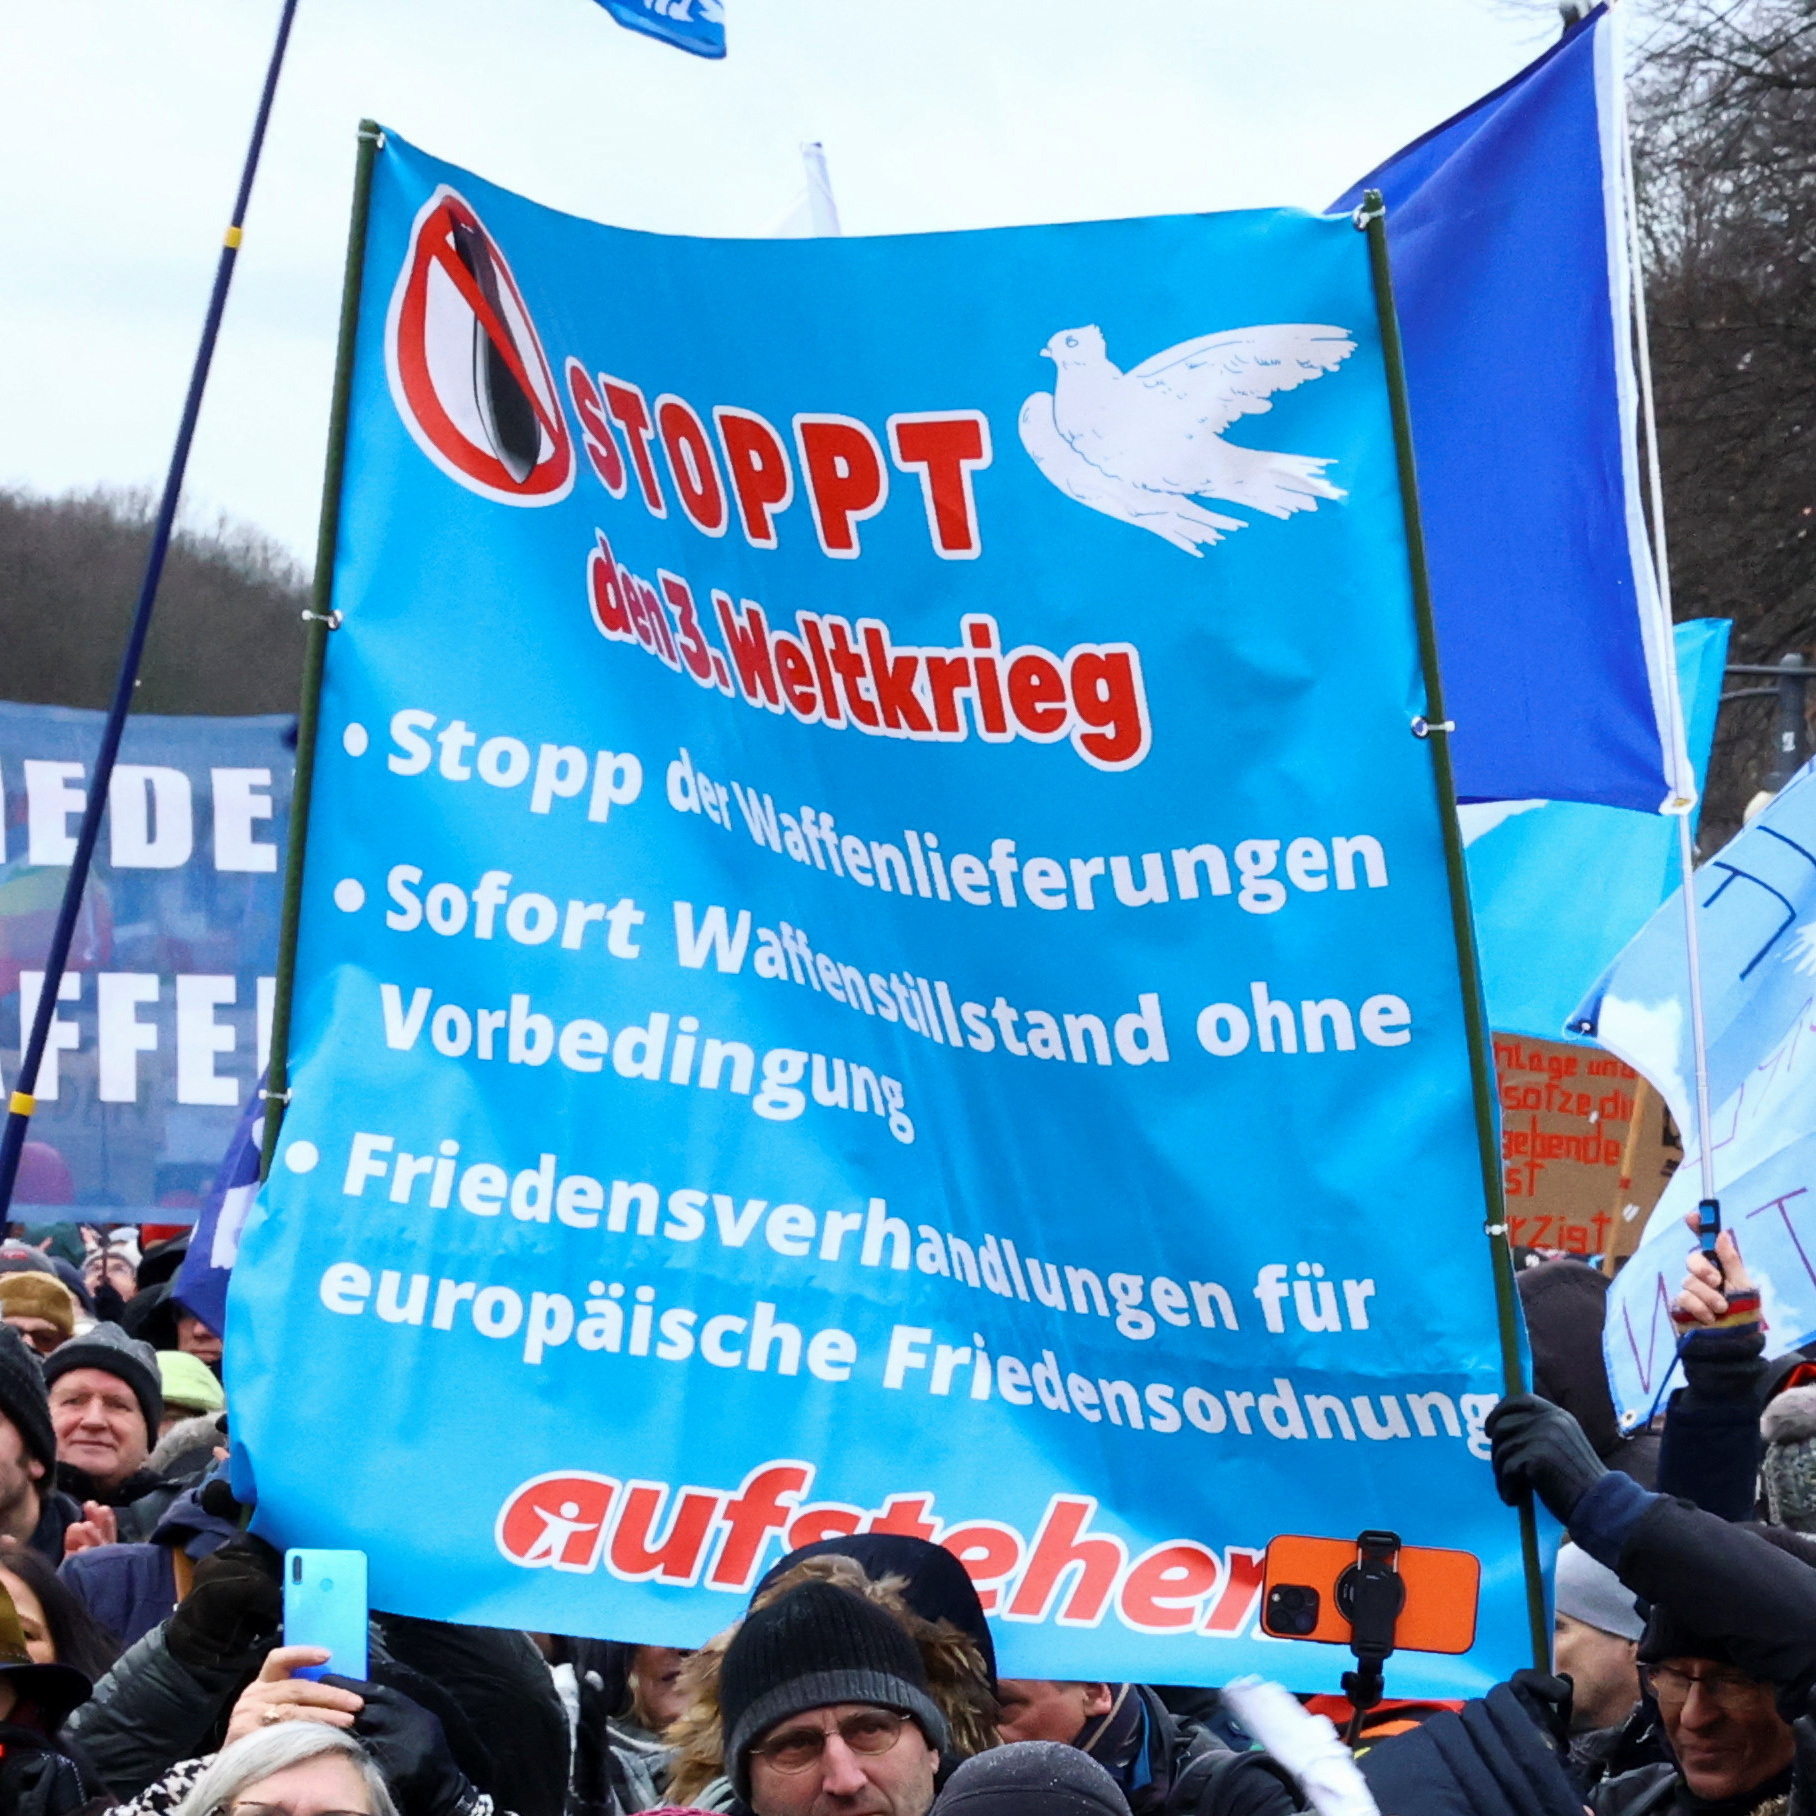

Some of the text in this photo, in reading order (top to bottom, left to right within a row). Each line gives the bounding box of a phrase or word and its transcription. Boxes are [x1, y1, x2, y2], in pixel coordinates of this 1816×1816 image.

[566, 356, 991, 560] STOPPT
[587, 528, 1152, 770] den 3. Weltkrieg
[0, 760, 280, 873] EDE
[388, 708, 1388, 915] Stopp der Waffenlieferungen
[0, 971, 276, 1107] FFE
[378, 985, 916, 1145] Vorbedingung
[386, 866, 1412, 1064] Sofort Waffenstillstand ohne
[341, 1131, 1240, 1341] Friedensverhandlungen
[1253, 1263, 1376, 1334] für
[318, 1259, 1500, 1459] europäische Friedensordnung
